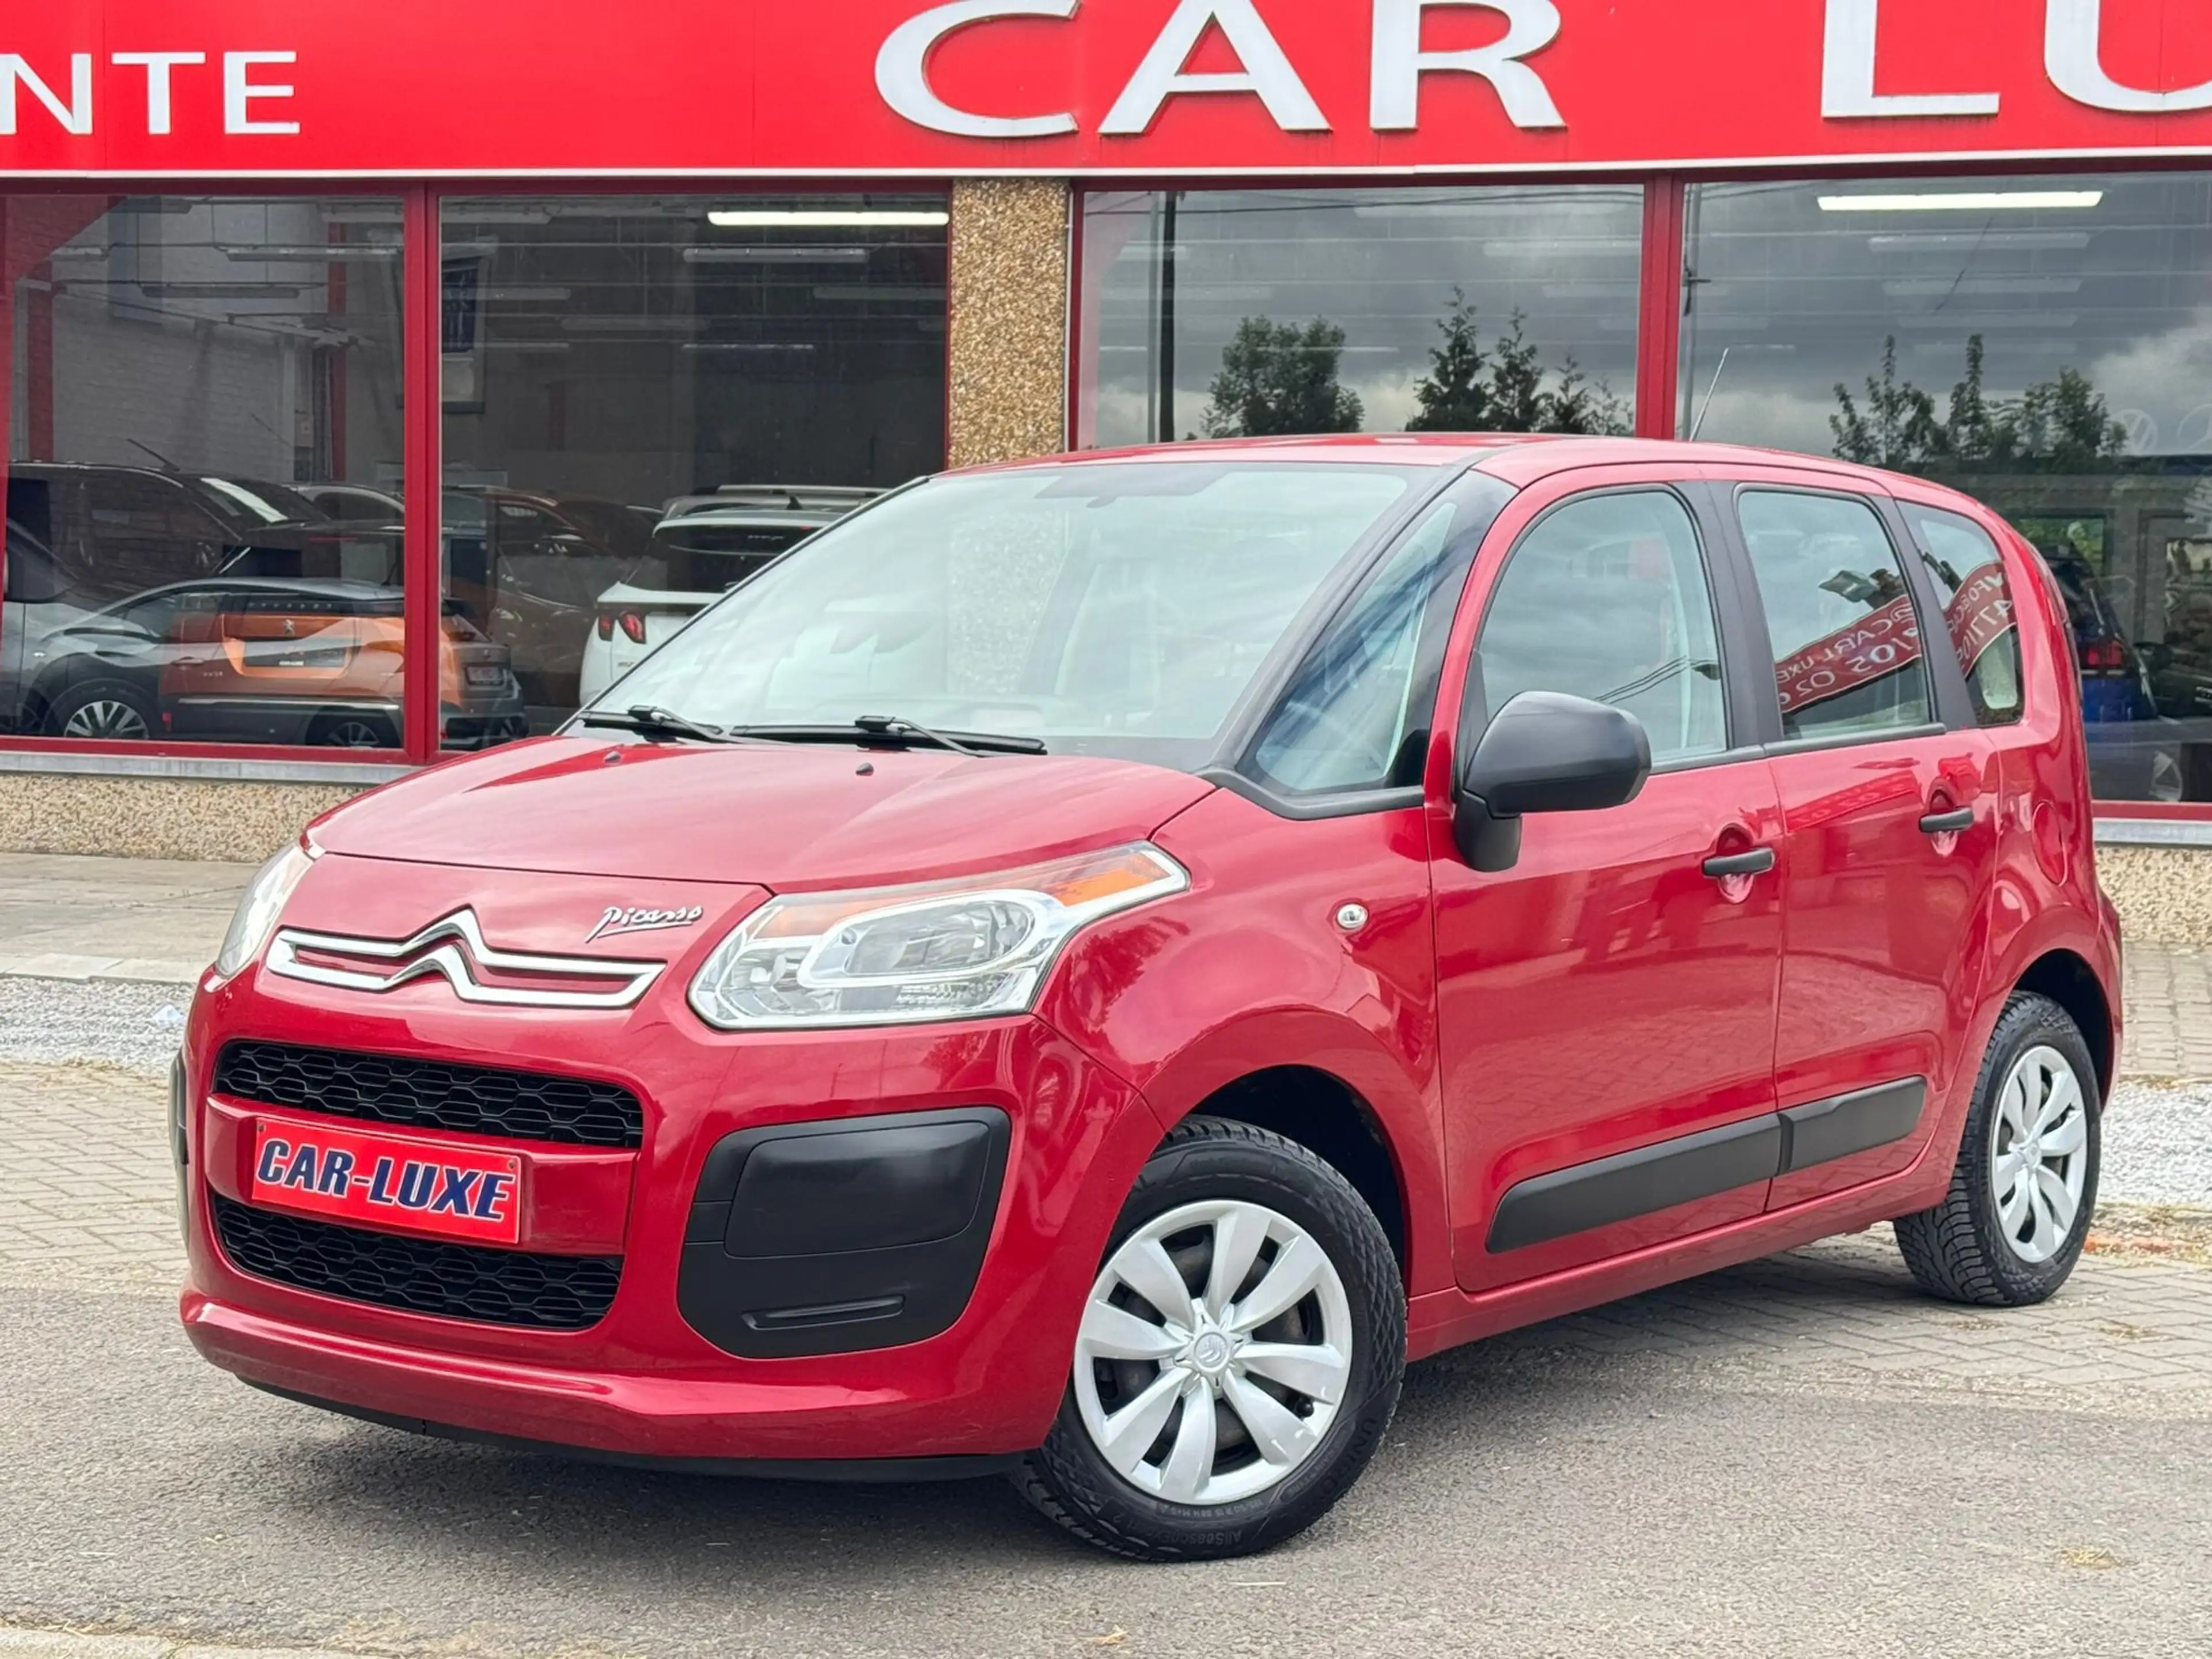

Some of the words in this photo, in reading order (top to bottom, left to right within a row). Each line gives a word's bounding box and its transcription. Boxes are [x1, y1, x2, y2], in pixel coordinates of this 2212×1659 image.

[0, 51, 300, 135] NTE
[874, 0, 1568, 138] CAR
[1821, 0, 2212, 118] LU
[584, 906, 703, 944] Picasso
[257, 1138, 516, 1221] CAR-LUXE
